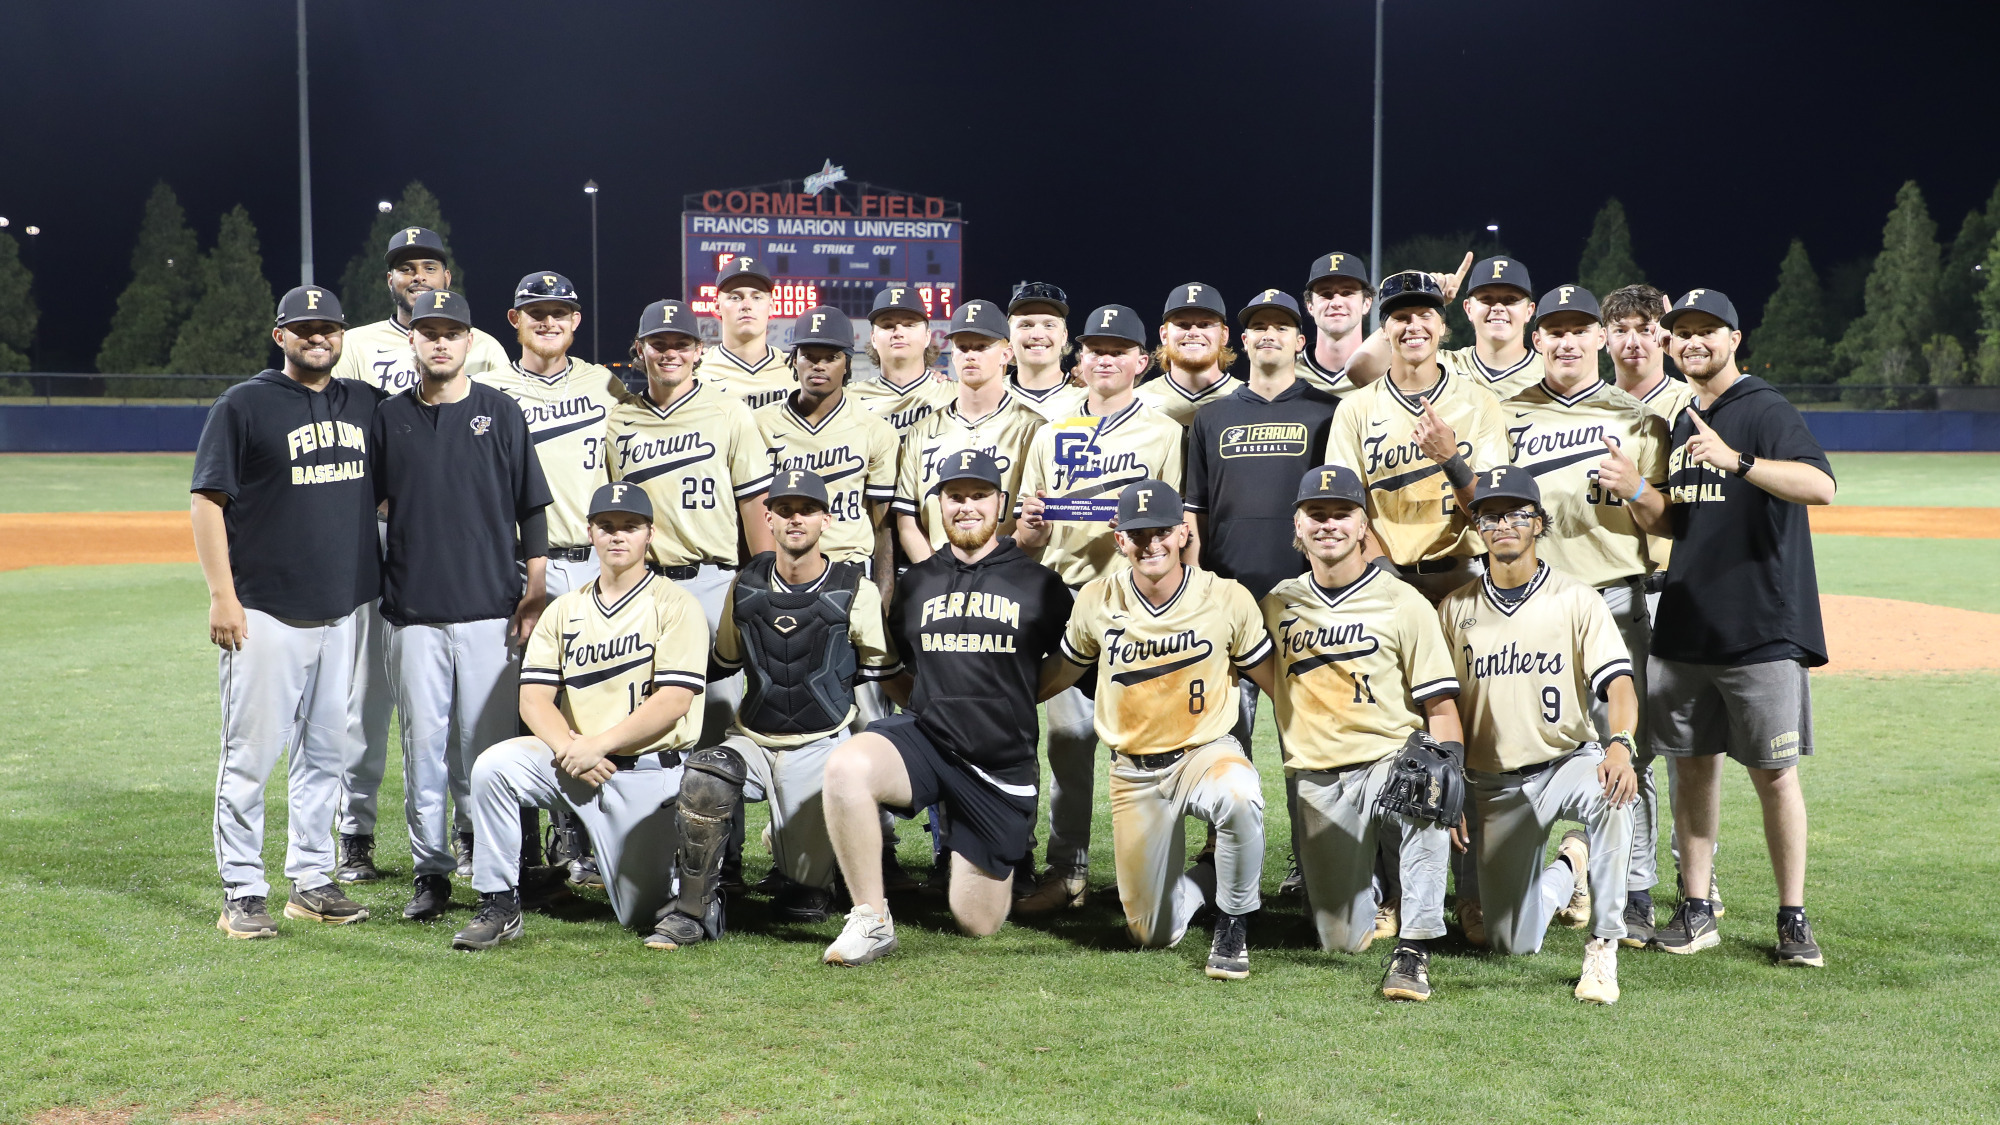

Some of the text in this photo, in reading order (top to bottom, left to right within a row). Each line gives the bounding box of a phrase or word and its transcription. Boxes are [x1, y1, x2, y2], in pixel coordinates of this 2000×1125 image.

[702, 189, 945, 218] CORMELL FIELD
[406, 228, 421, 245] F
[693, 216, 952, 238] FRANCIS MARION UNIVERSITY
[700, 241, 897, 256] BATTER BALL STRIKE OUT
[740, 257, 754, 272] F
[1329, 255, 1344, 271] F
[1492, 260, 1508, 279] F
[306, 290, 323, 310] F
[434, 291, 451, 309] F
[890, 288, 905, 305] F
[940, 289, 950, 302] 2
[1187, 285, 1202, 303] F
[1263, 288, 1280, 302] F
[1559, 286, 1575, 305] F
[1684, 289, 1705, 307] F
[663, 305, 678, 324] F
[811, 313, 826, 333] F
[965, 304, 982, 322] F
[1101, 309, 1118, 328] F
[287, 420, 366, 461] FERRUM
[1250, 426, 1304, 441] FERRUM
[1508, 422, 1605, 464] Ferrum
[616, 431, 701, 470] Ferrum
[1235, 444, 1288, 453] BASEBALL
[766, 444, 851, 477] Ferrum
[959, 451, 976, 471] F
[291, 460, 365, 485] BASEBALL
[787, 470, 804, 489] F
[1320, 470, 1336, 491] F
[1490, 468, 1507, 489] F
[611, 484, 628, 503] F
[682, 476, 716, 509] 29
[1136, 489, 1153, 512] F
[830, 490, 861, 522] 48
[921, 591, 1020, 630] FERRUM
[921, 633, 1017, 654] BASEBALL
[1104, 627, 1196, 667] Ferrum
[1279, 615, 1364, 660] Ferrum
[562, 630, 641, 671] Ferrum
[1462, 640, 1566, 681] Panthers
[1189, 678, 1205, 716] 8
[1350, 671, 1377, 704] 11
[1541, 685, 1561, 724] 9
